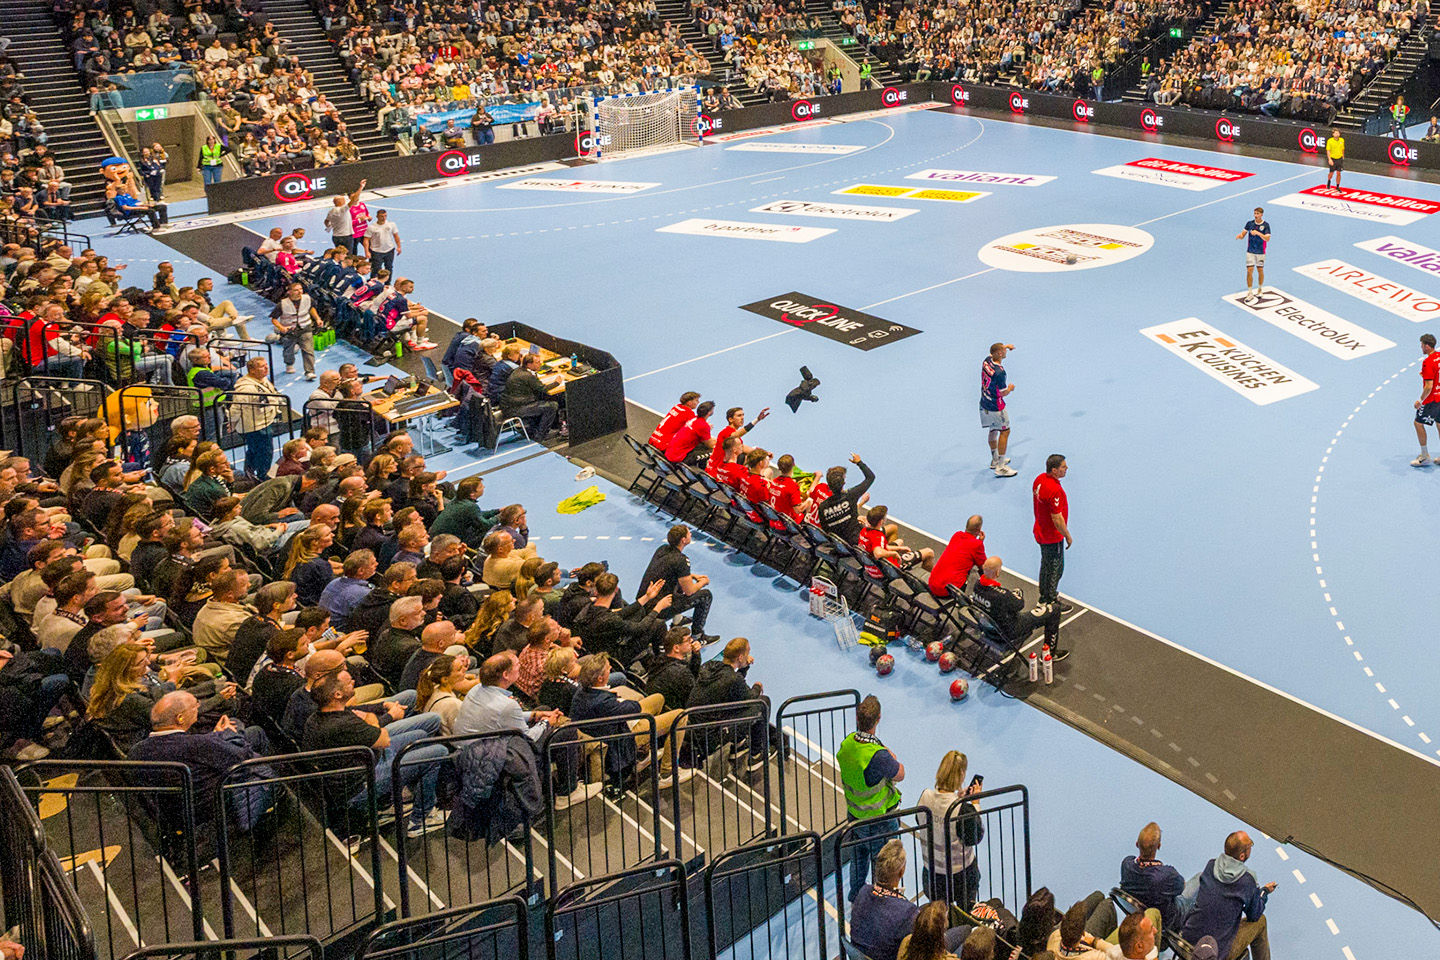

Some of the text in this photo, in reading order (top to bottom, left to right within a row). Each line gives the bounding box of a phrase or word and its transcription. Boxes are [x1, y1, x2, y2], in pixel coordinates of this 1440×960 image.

[927, 172, 1038, 186] valiant
[1164, 162, 1243, 181] Mobiliar
[804, 206, 899, 218] Electrolux
[1345, 190, 1439, 213] Mobiliar
[1275, 306, 1367, 351] Electrolux
[1195, 352, 1268, 390] CUISINES
[1219, 344, 1293, 385] KÜCHEN
